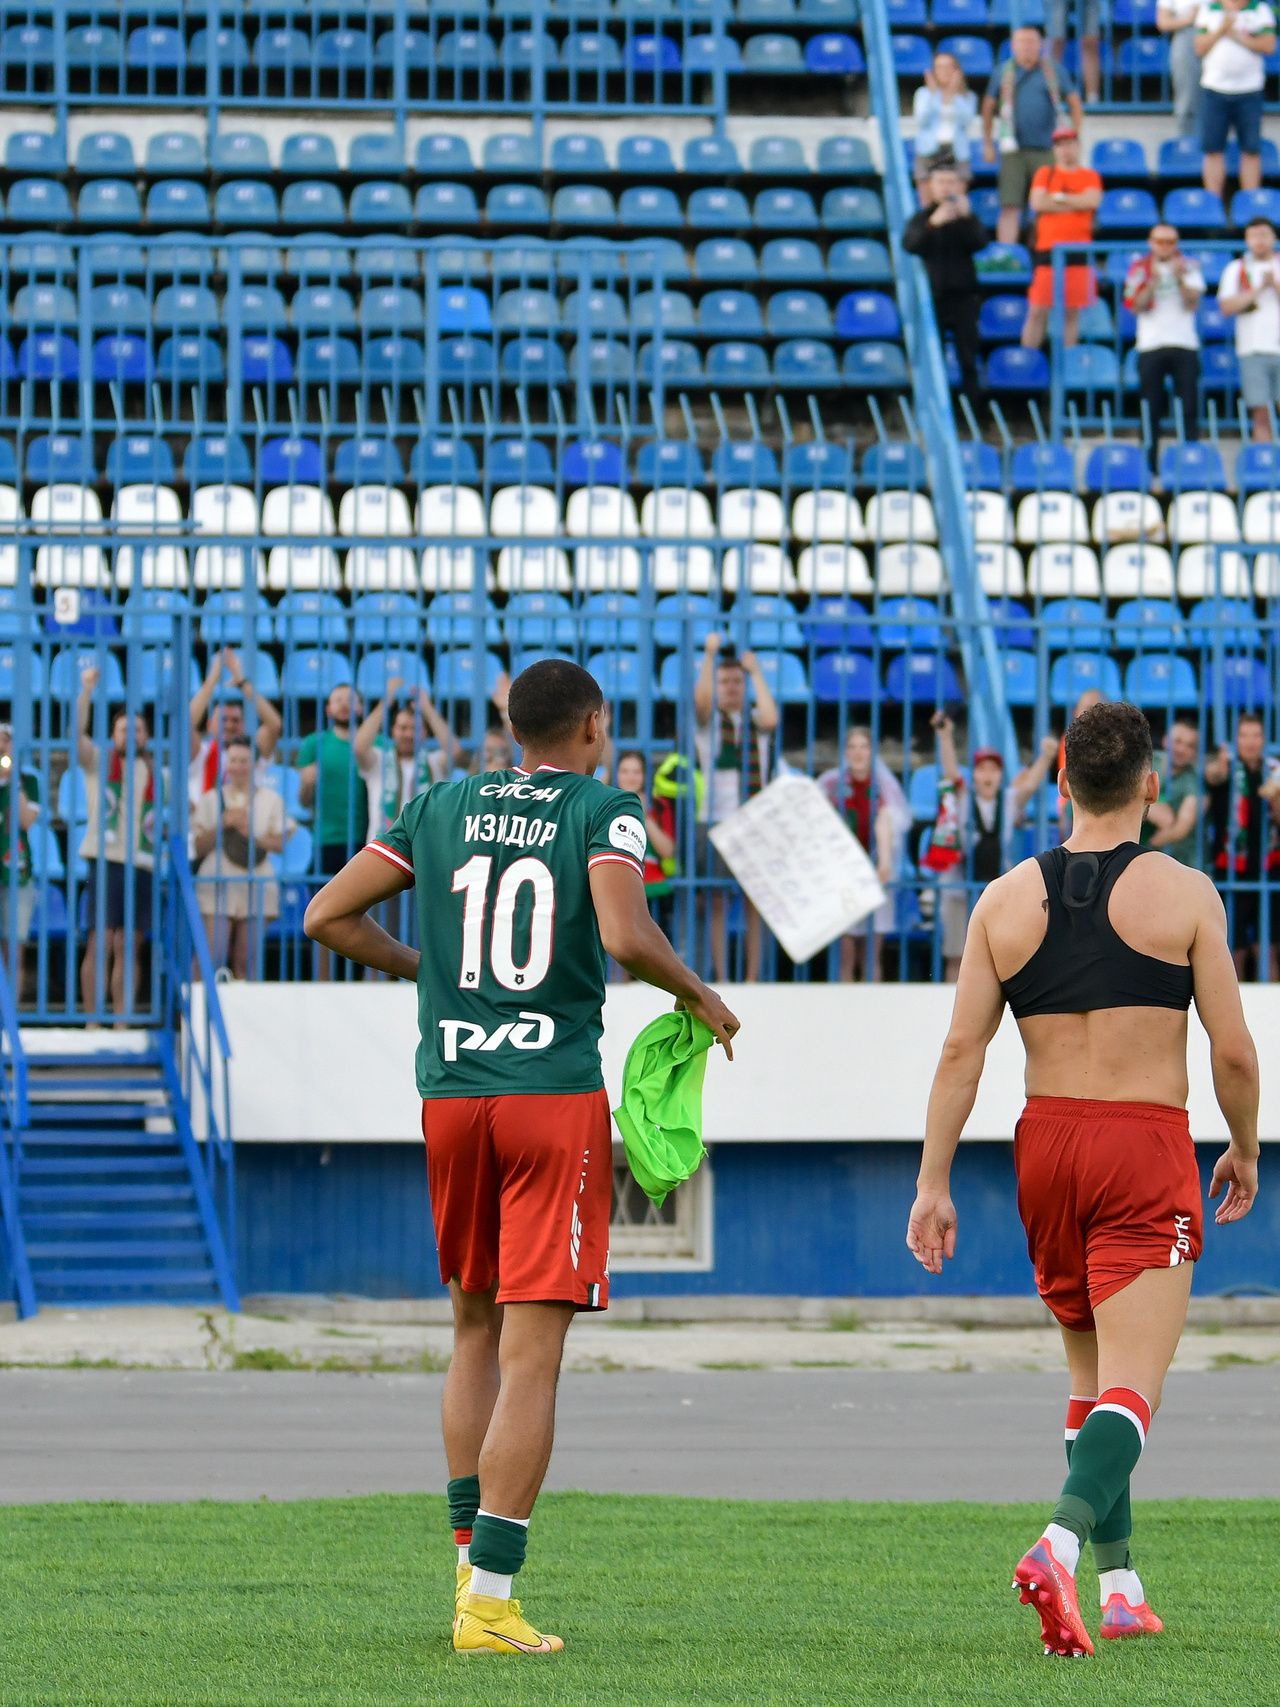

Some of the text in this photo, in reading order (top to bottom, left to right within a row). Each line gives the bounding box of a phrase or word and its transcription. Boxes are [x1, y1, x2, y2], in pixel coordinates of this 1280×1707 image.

[464, 813, 558, 848] ИЗИДОР
[451, 854, 555, 991] 10
[1050, 1562, 1070, 1614] ULTRA
